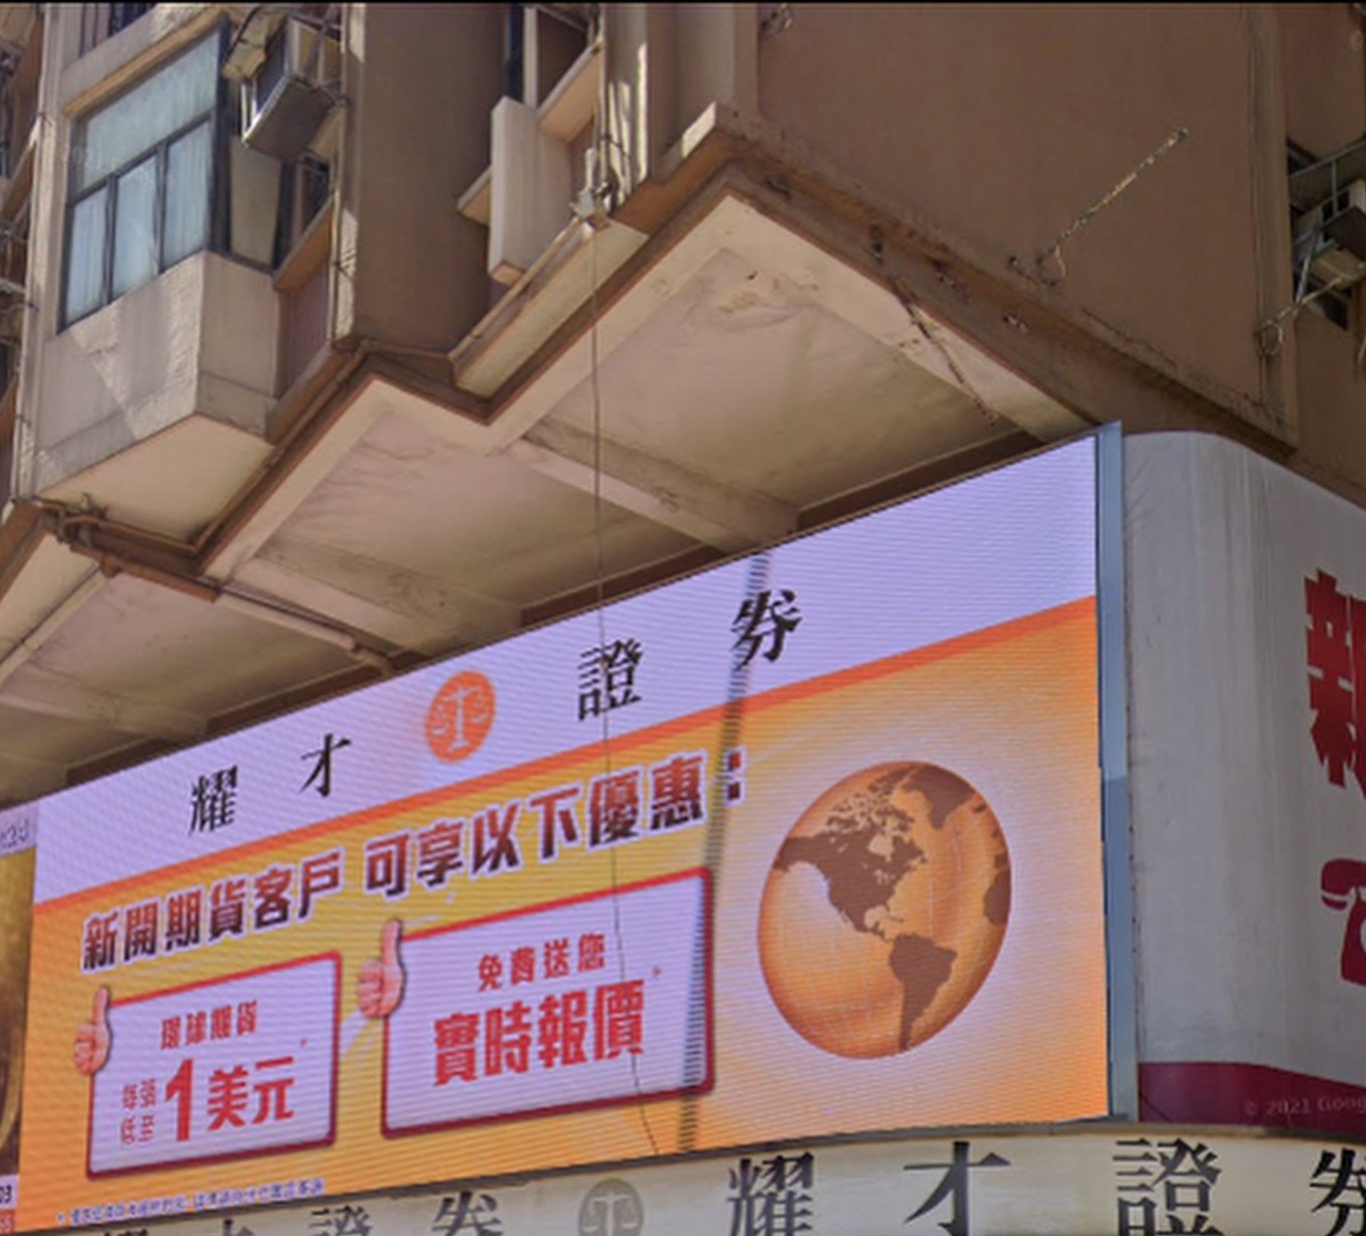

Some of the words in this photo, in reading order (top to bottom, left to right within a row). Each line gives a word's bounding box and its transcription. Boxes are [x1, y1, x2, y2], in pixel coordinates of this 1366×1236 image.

[188, 734, 351, 837] 耀才
[577, 588, 803, 723] 證券
[82, 852, 341, 971] 新開期貨客戶
[477, 932, 607, 993] 免費送您
[432, 978, 645, 1087] 實時報價
[165, 1056, 296, 1143] 1美元
